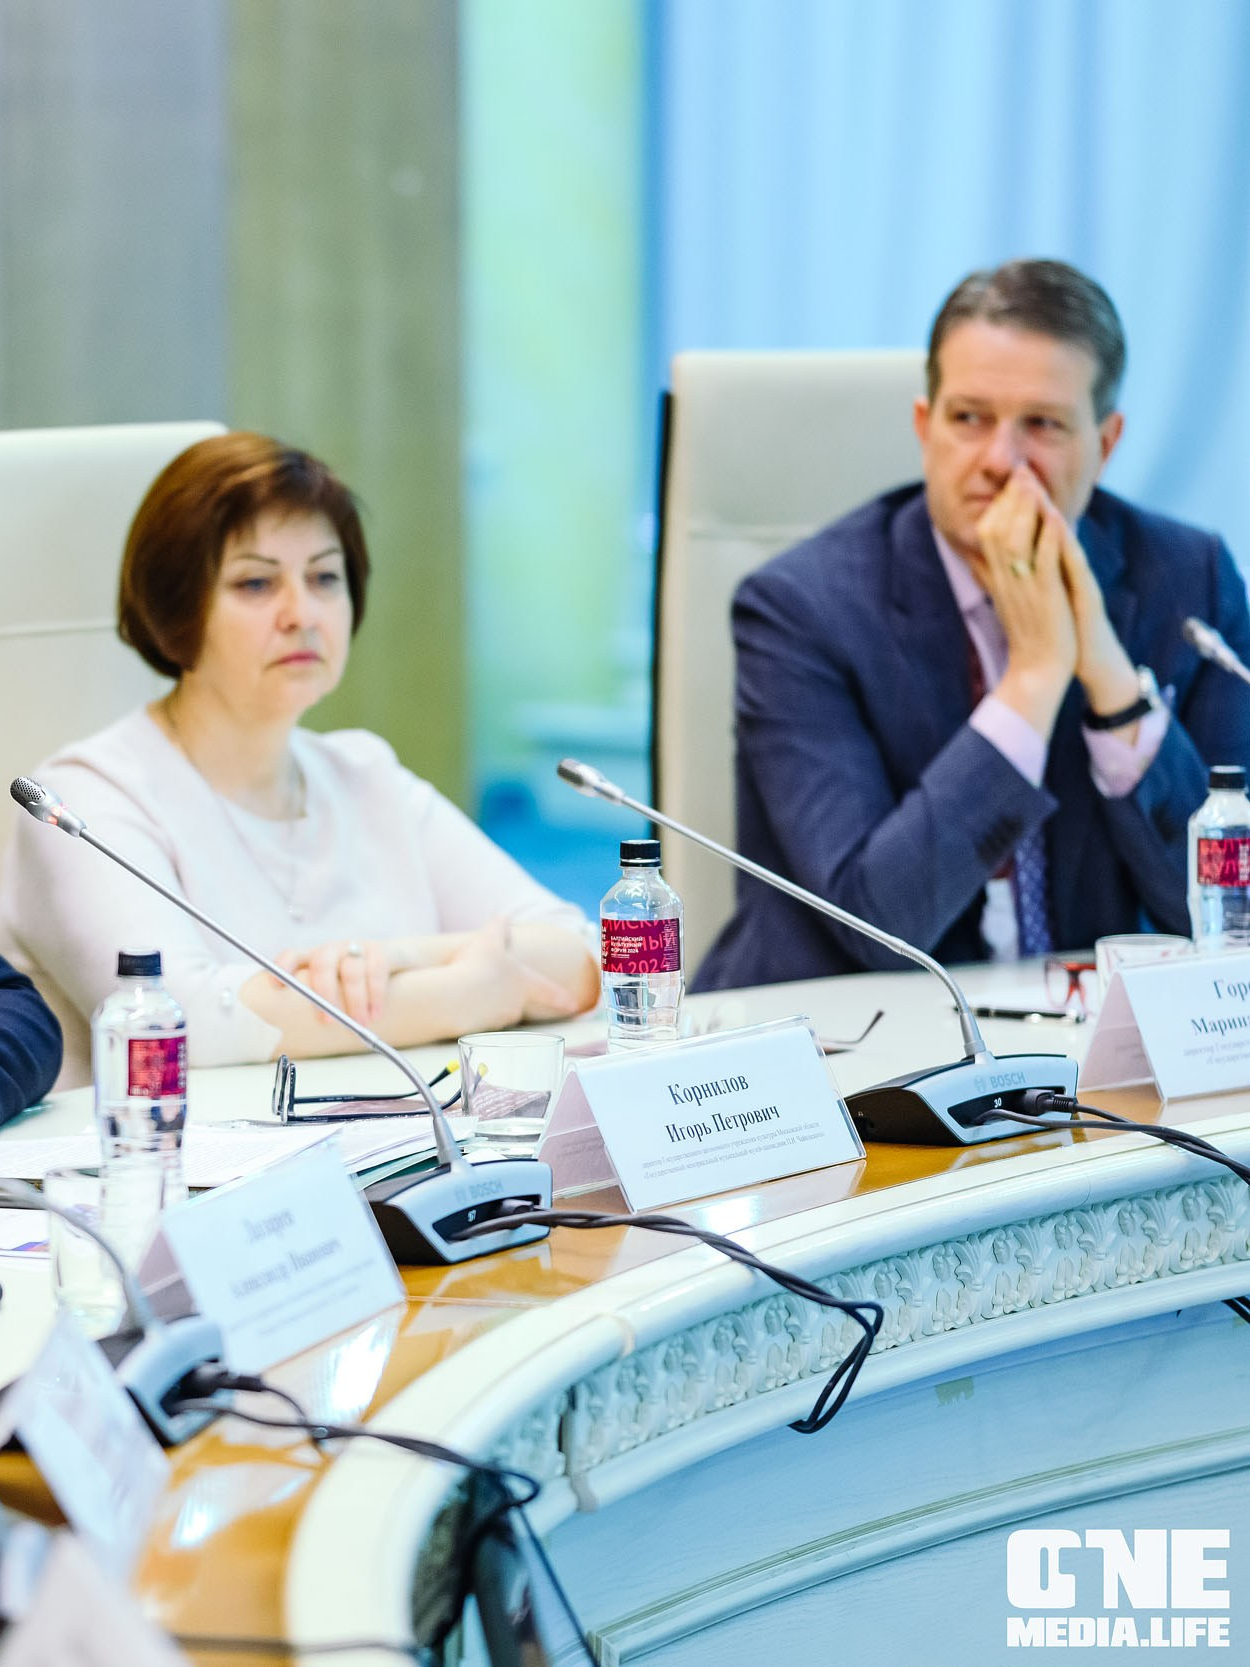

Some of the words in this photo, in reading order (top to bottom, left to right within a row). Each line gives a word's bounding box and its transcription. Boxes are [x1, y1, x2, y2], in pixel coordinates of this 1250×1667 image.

[667, 1073, 750, 1106] Корнилов
[990, 1071, 1027, 1088] BOSCH
[664, 1123, 712, 1143] Игорь
[711, 1105, 780, 1132] Петрович
